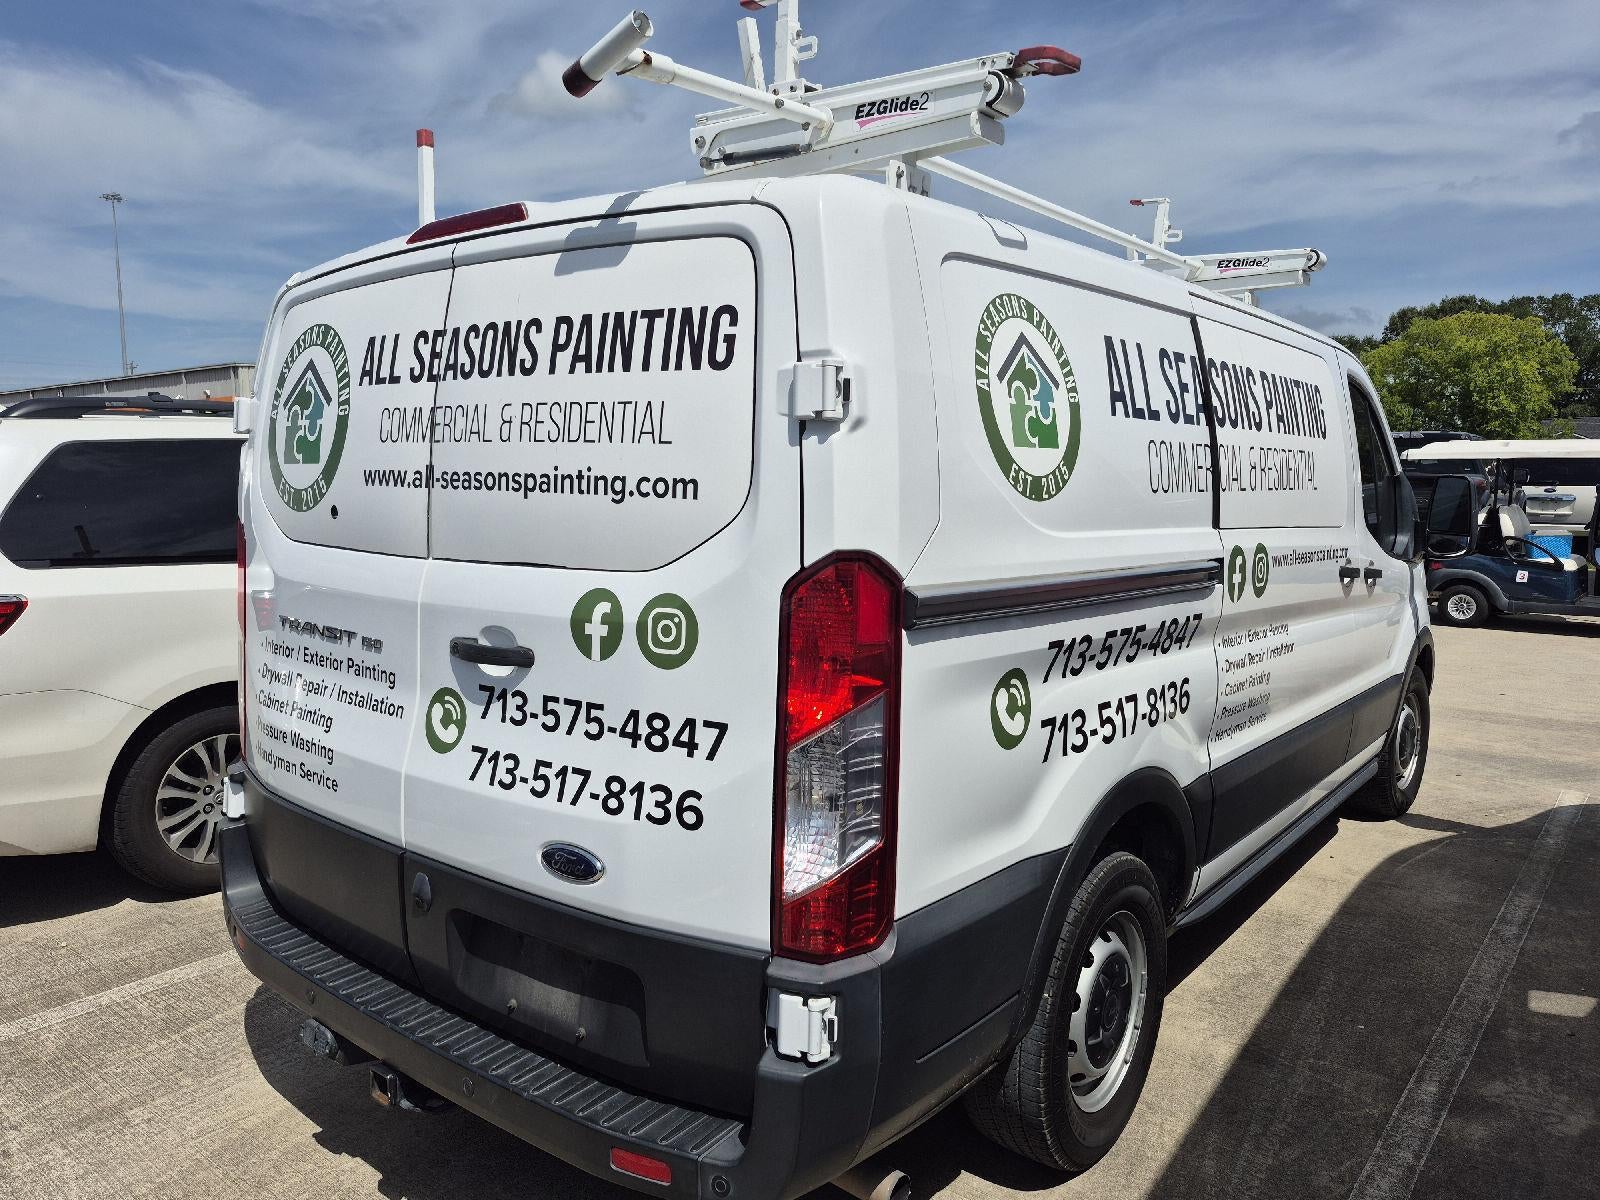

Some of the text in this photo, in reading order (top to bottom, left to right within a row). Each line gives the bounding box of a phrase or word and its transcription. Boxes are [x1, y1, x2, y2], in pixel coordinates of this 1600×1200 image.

[855, 91, 930, 120] EZGlide2
[1217, 256, 1270, 269] EZGlide2
[282, 325, 325, 378] SEASONS
[324, 329, 350, 415] PAINTING
[358, 304, 739, 387] ALL SEASONS PAINTING
[976, 295, 1079, 403] ALL SEASONS PAINTING
[1103, 334, 1328, 441] ALL SEASONS PAINTING
[379, 400, 673, 445] COMMERCIAL & RESIDENTIAL
[302, 474, 327, 510] 2015
[363, 464, 700, 504] www.all-seasonspainting.com
[1008, 460, 1069, 499] EST. 2015
[1147, 439, 1318, 494] COMMERCIAL & RESIDENTIAL
[278, 614, 359, 643] TRANSIT
[1042, 612, 1203, 685] 713-575-4847
[264, 637, 295, 660] Interior
[303, 646, 344, 673] Exterior
[347, 657, 396, 690] Painting
[258, 689, 334, 734] Cabinet Painting
[261, 662, 294, 686] Drywall
[337, 684, 405, 720] Installation
[477, 683, 729, 762] 713-575-4847
[1040, 677, 1191, 764] 713-517-8136
[290, 729, 335, 766] Washing
[299, 762, 340, 793] Service
[468, 744, 705, 832] 713-517-8136
